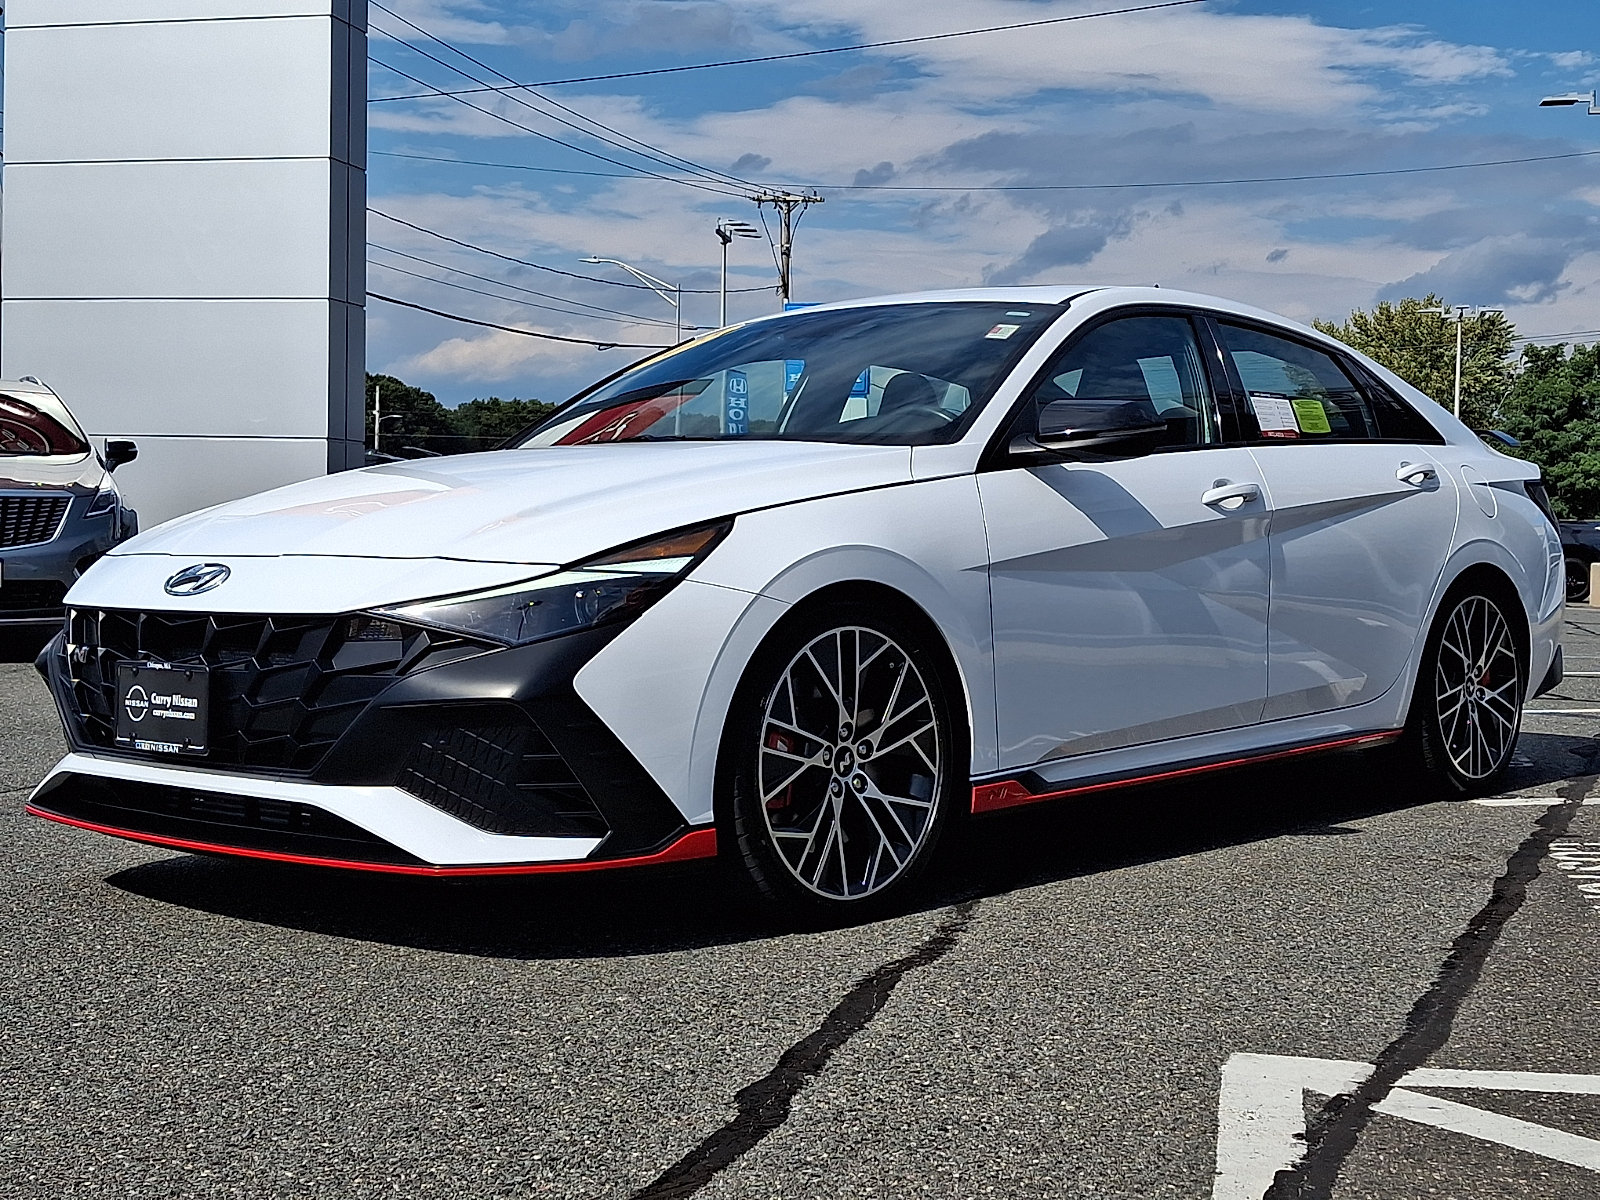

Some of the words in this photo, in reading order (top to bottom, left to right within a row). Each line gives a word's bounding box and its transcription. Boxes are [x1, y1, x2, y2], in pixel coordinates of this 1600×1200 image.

[124, 699, 149, 708] NISSAN
[150, 692, 172, 708] Curry
[172, 694, 198, 708] Nissan
[150, 743, 179, 754] NISSAN
